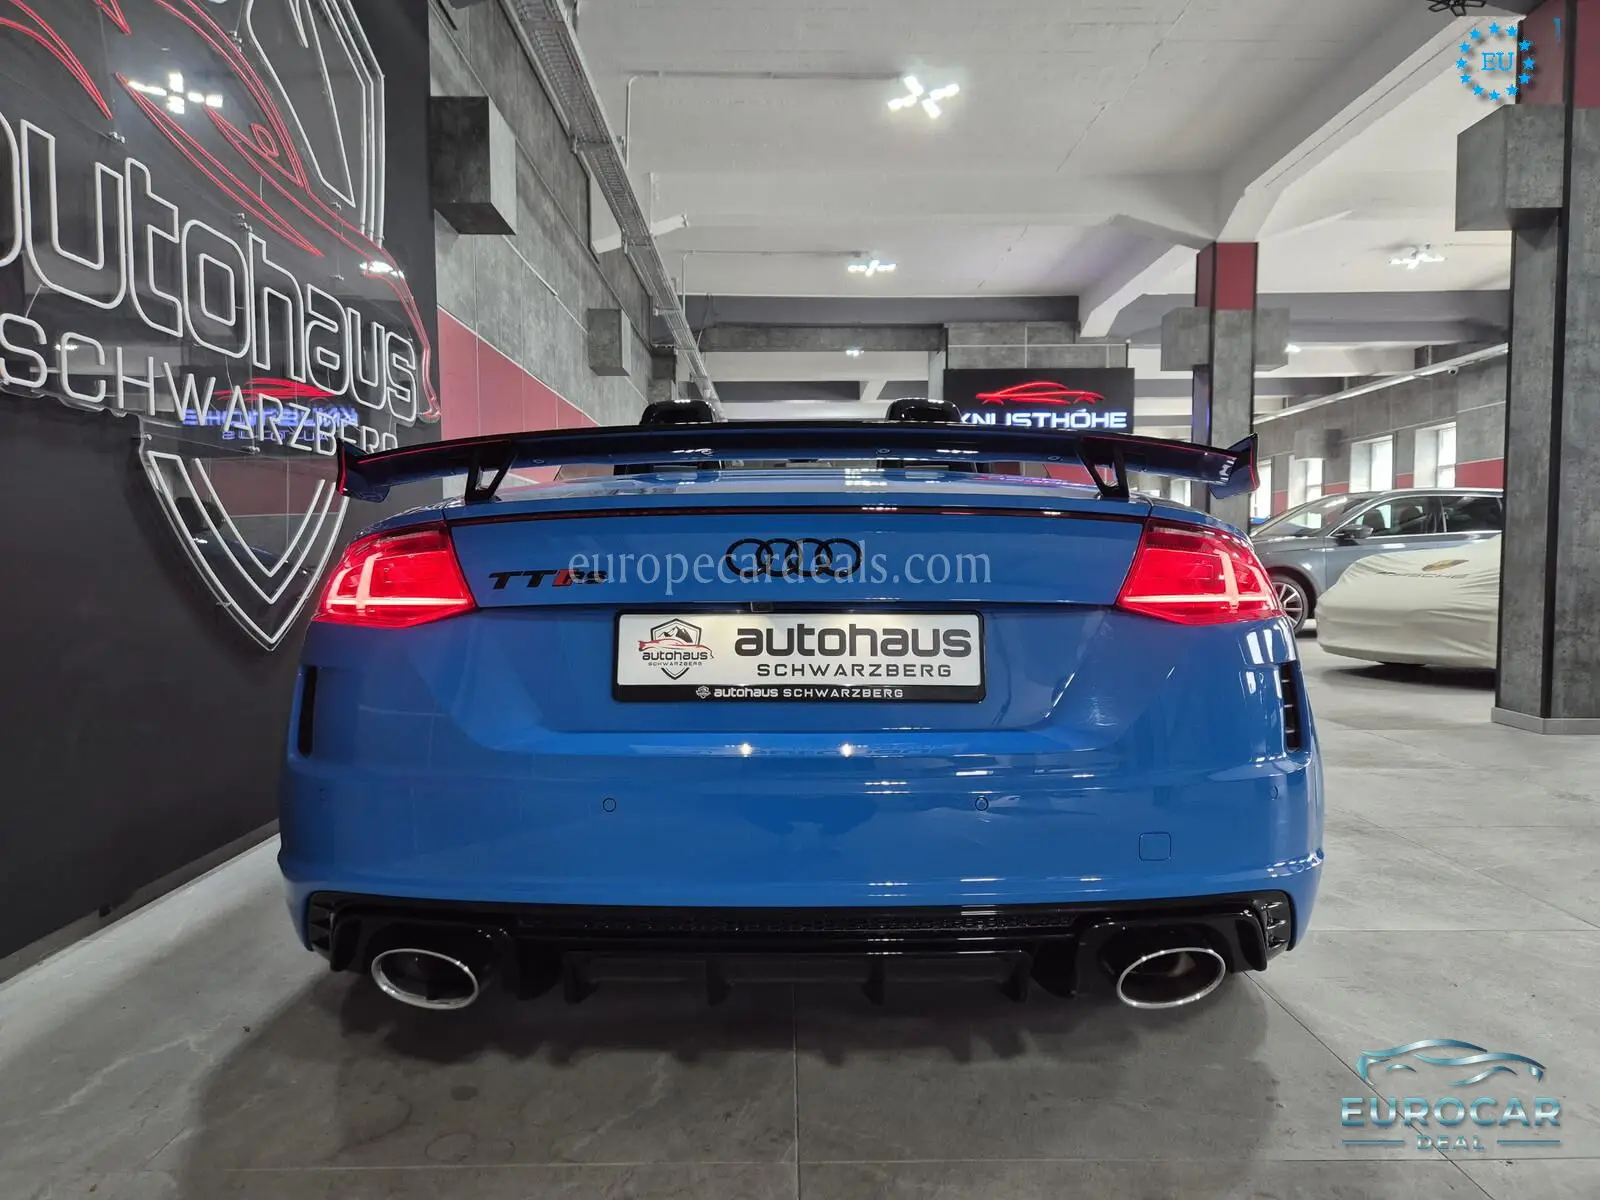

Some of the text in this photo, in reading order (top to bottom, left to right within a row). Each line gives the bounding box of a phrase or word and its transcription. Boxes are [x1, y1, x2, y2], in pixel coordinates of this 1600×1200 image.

[0, 111, 417, 423] utohaus
[735, 623, 972, 658] autohaus
[642, 650, 708, 661] autohaus
[756, 662, 952, 678] SCHWARZBERG
[713, 687, 904, 699] autohaus SCHWARZBERG
